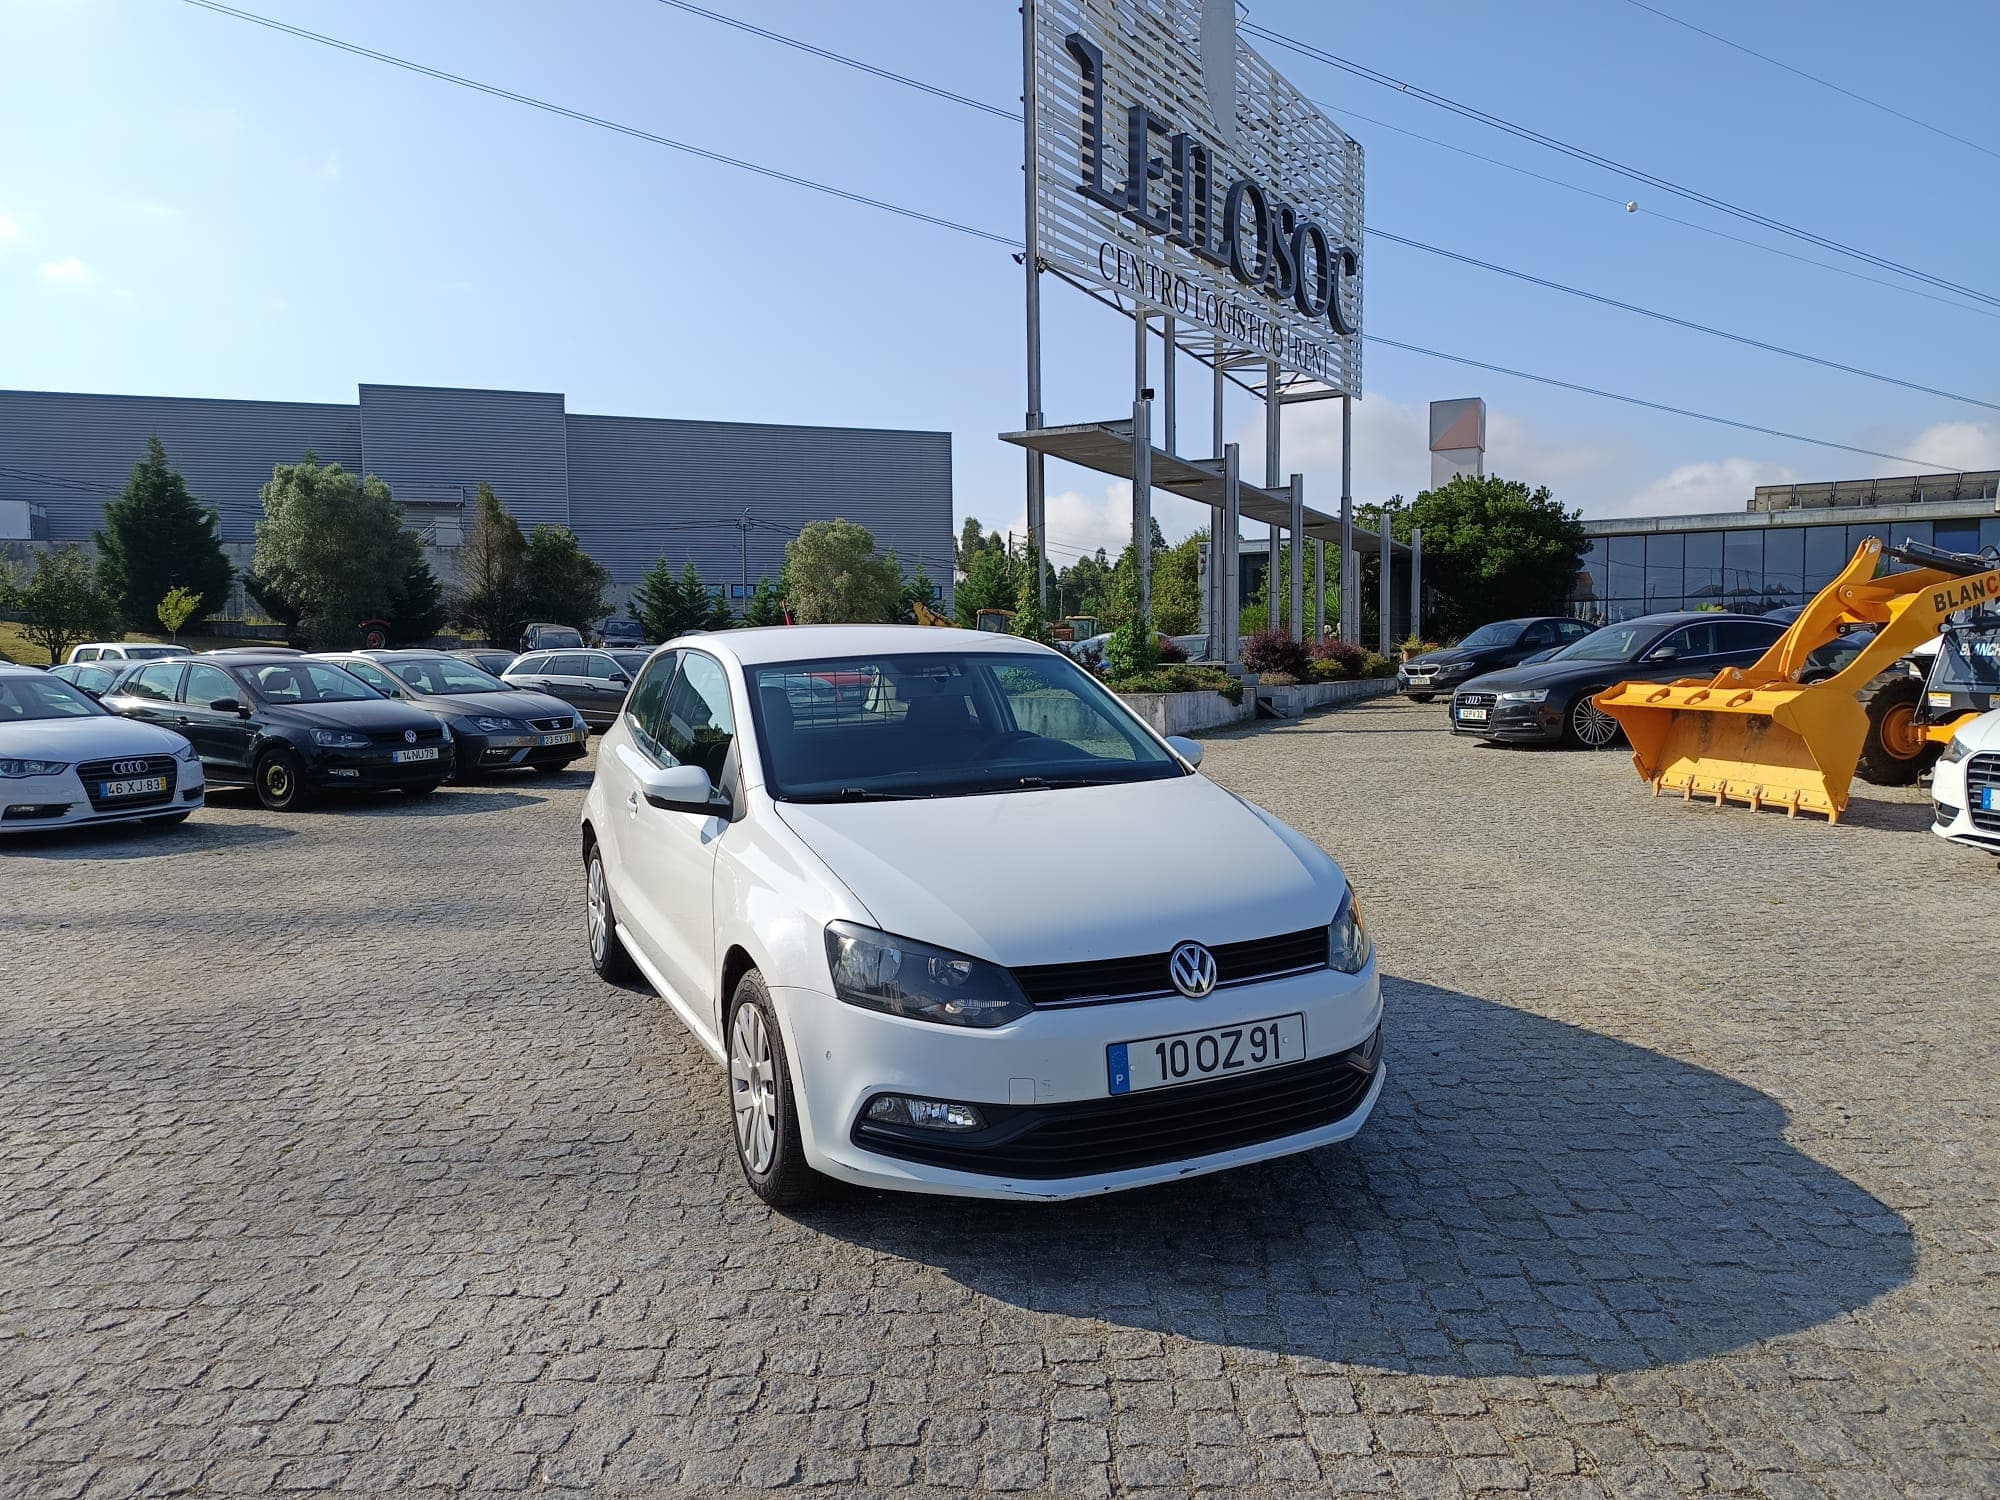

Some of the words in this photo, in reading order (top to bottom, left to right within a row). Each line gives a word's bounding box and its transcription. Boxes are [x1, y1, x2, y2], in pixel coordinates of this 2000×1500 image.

[1099, 242, 1188, 313] CENTRO
[1295, 336, 1331, 378] RENT
[1933, 573, 2000, 612] BLANC
